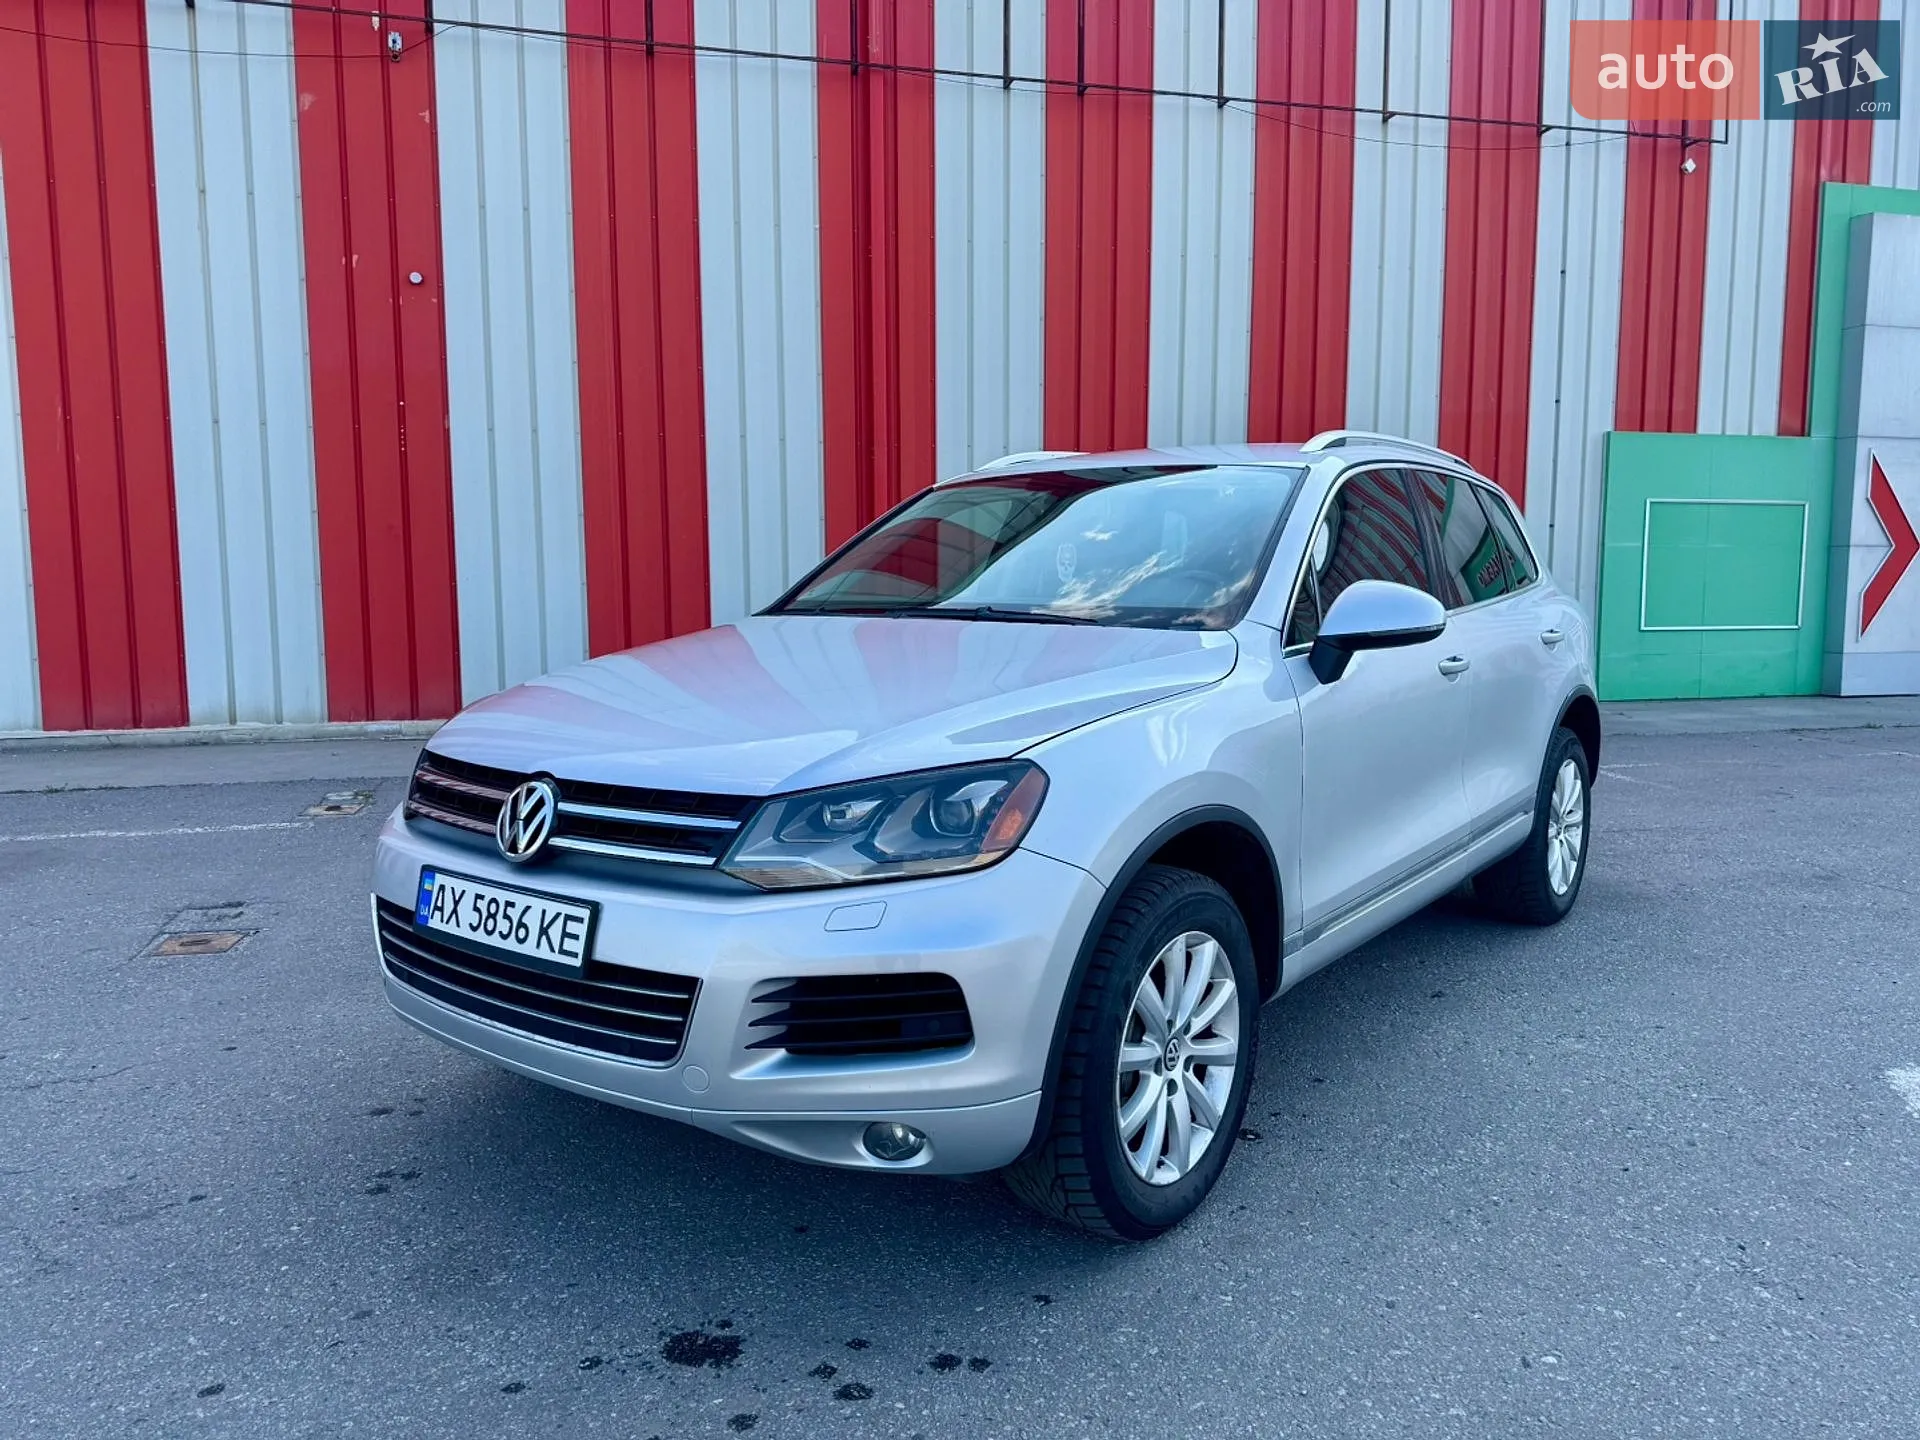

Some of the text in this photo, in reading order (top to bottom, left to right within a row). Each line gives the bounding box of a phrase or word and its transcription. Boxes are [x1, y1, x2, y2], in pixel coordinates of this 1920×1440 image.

[497, 781, 554, 862] VW
[430, 884, 585, 959] AX 5856 KE
